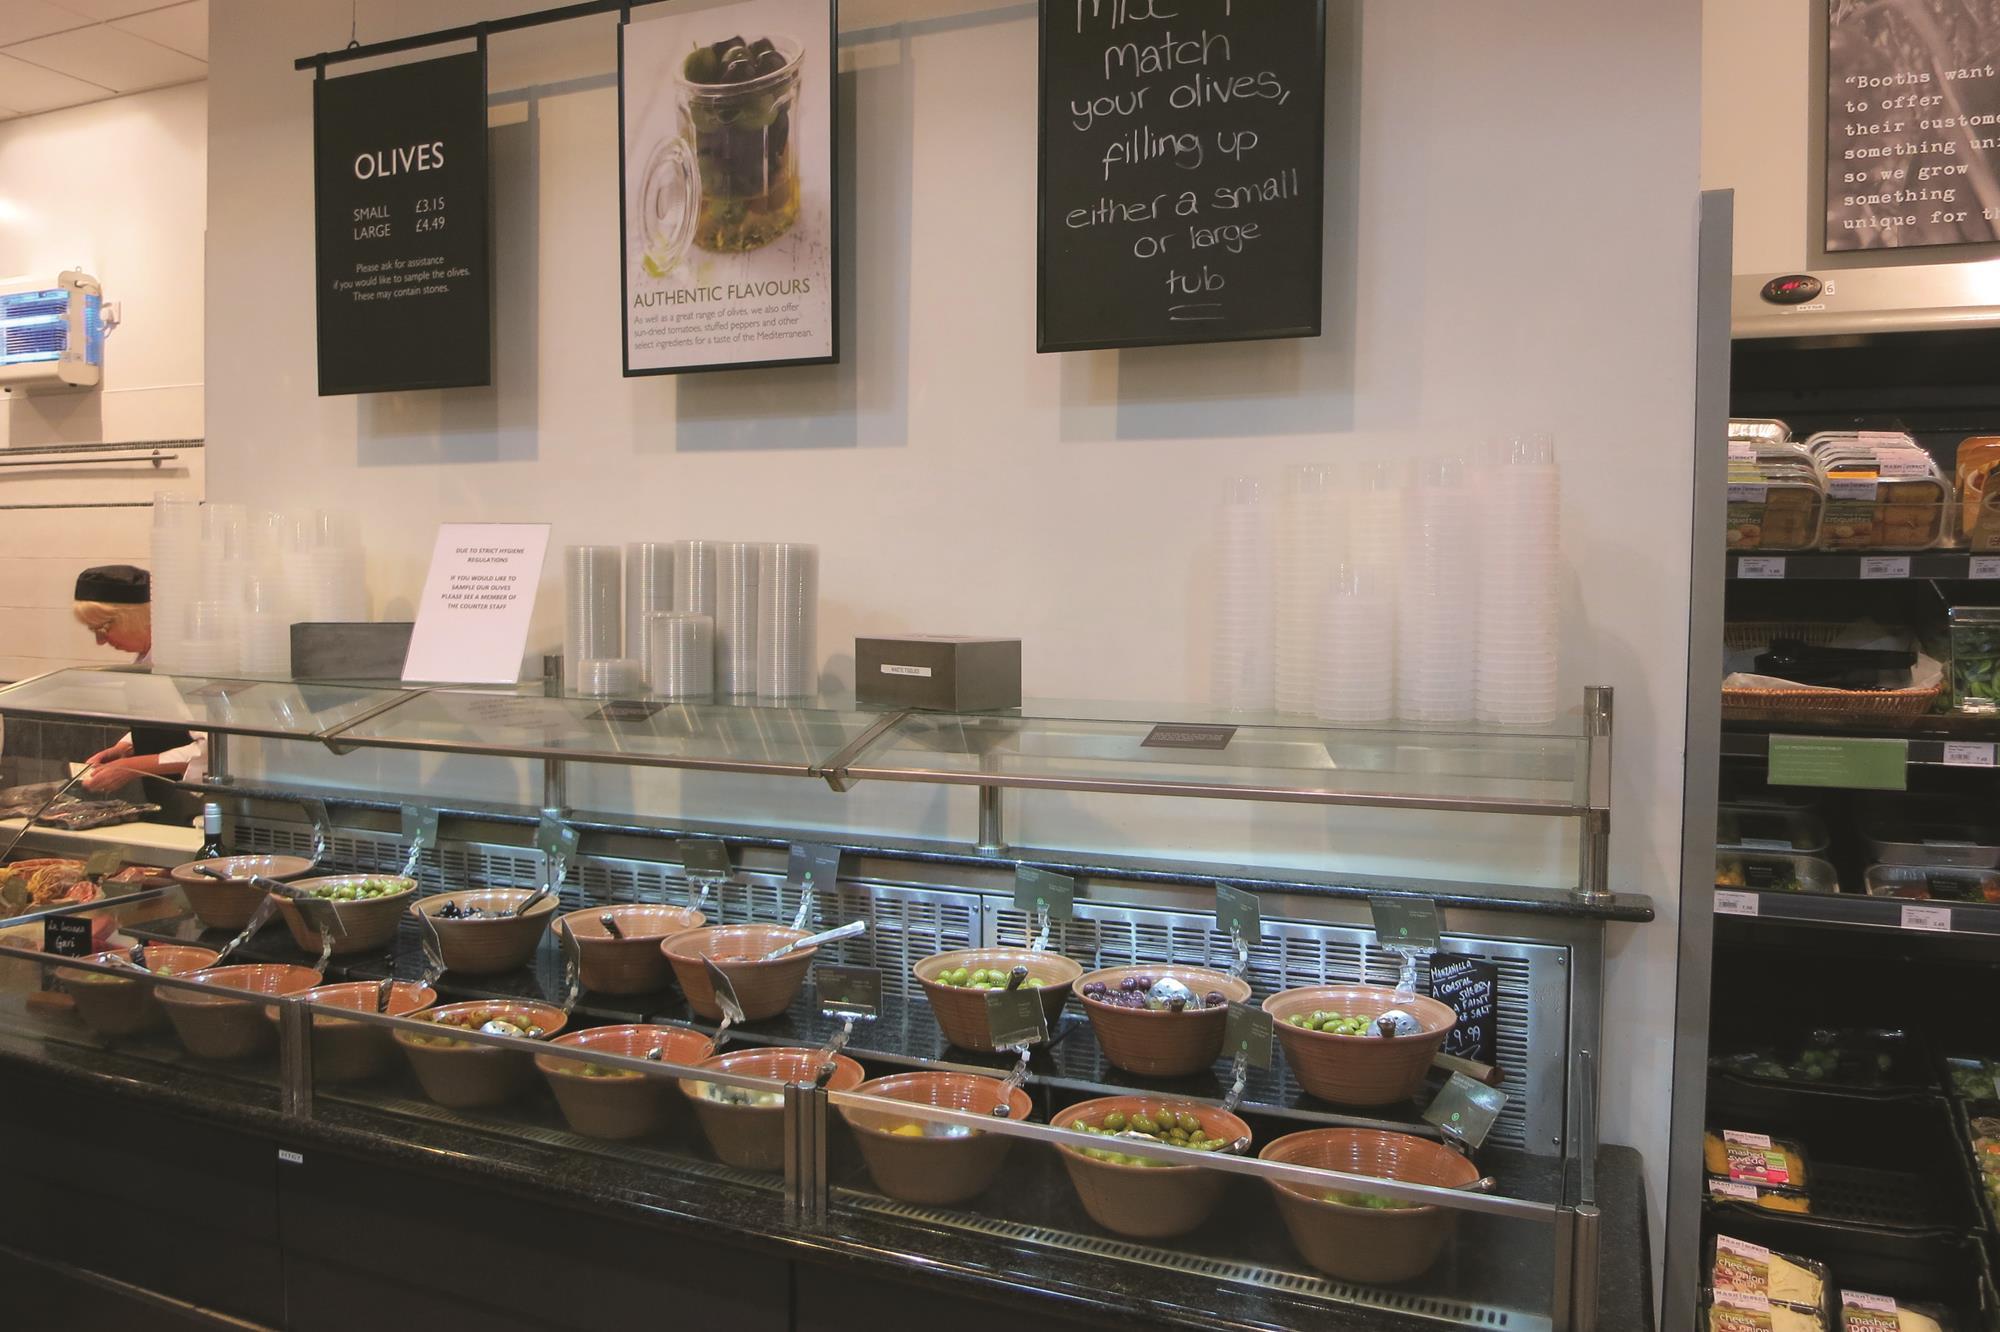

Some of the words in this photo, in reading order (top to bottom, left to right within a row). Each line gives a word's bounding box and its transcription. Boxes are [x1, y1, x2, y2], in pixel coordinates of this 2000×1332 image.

[1944, 64, 1994, 81] want
[1071, 86, 1151, 131] your
[1169, 71, 1291, 109] olives,
[1844, 100, 1868, 113] to
[1881, 94, 1943, 110] offer
[1844, 121, 1905, 136] their
[1102, 125, 1204, 182] filling
[1217, 130, 1258, 161] up
[1844, 140, 1956, 160] something
[354, 141, 445, 180] OLIVES
[1844, 172, 1867, 183] so
[1880, 169, 1905, 180] we
[1917, 164, 1969, 181] grow
[1065, 193, 1167, 229] either
[1175, 191, 1199, 216] a
[1211, 168, 1299, 209] small
[1844, 188, 1956, 207] something
[353, 204, 391, 222] SMALL
[415, 196, 446, 213] £3.15
[353, 223, 392, 241] LARGE
[415, 216, 446, 233] £4.49
[1843, 214, 1917, 231] unique
[1930, 210, 1968, 224] for
[1133, 233, 1176, 259] or
[1190, 222, 1262, 254] large
[355, 263, 380, 273] Please
[380, 261, 393, 271] ask
[394, 258, 406, 269] for
[407, 255, 445, 268] assistance
[339, 280, 354, 291] you
[354, 276, 378, 288] would
[378, 274, 392, 285] like
[393, 274, 402, 284] to
[403, 270, 431, 283] sample
[431, 269, 445, 279] the
[446, 266, 470, 278] olives.
[1165, 265, 1225, 294] tub
[352, 290, 375, 301] These
[376, 289, 393, 300] may
[393, 287, 421, 298] contain
[422, 283, 450, 295] stones.
[633, 286, 723, 309] AUTHENTIC
[727, 278, 811, 300] FLAVOURS
[634, 315, 643, 324] As
[644, 314, 659, 324] well
[675, 311, 694, 323] great
[695, 311, 716, 321] range
[717, 308, 726, 318] of
[751, 307, 763, 315] we
[764, 304, 780, 314] also
[780, 302, 799, 313] offer
[703, 320, 729, 332] stuffed
[730, 320, 761, 331] peppers
[762, 318, 777, 327] and
[778, 317, 799, 327] other
[655, 337, 694, 350] ingredients
[694, 335, 706, 345] for
[713, 334, 732, 344] taste
[732, 332, 742, 343] of
[742, 333, 755, 342] the
[1432, 985, 1440, 998] A
[1440, 976, 1473, 994] COASTAL
[1470, 1004, 1492, 1019] SALT
[1727, 1148, 1764, 1158] mashed
[1727, 1155, 1765, 1165] swede
[1718, 1257, 1754, 1273] cheese
[1735, 1270, 1765, 1285] onion
[1719, 1312, 1757, 1326] cheese
[1849, 1316, 1897, 1329] mashed
